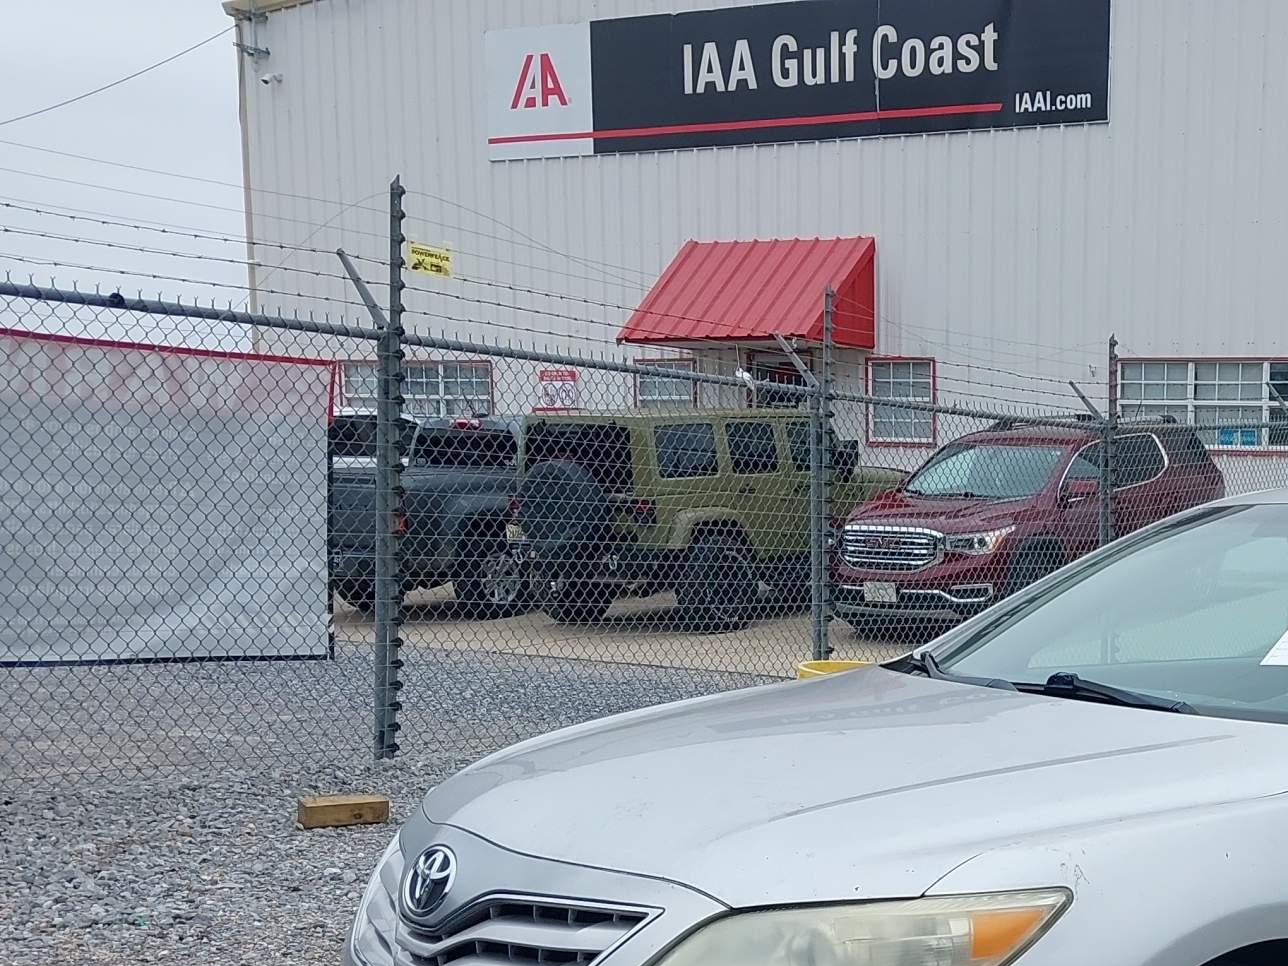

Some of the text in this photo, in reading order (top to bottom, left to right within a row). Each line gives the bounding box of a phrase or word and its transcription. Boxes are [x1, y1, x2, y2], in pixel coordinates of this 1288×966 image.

[683, 22, 998, 95] IAA Gulf Coast
[1015, 91, 1092, 113] IAAI.com
